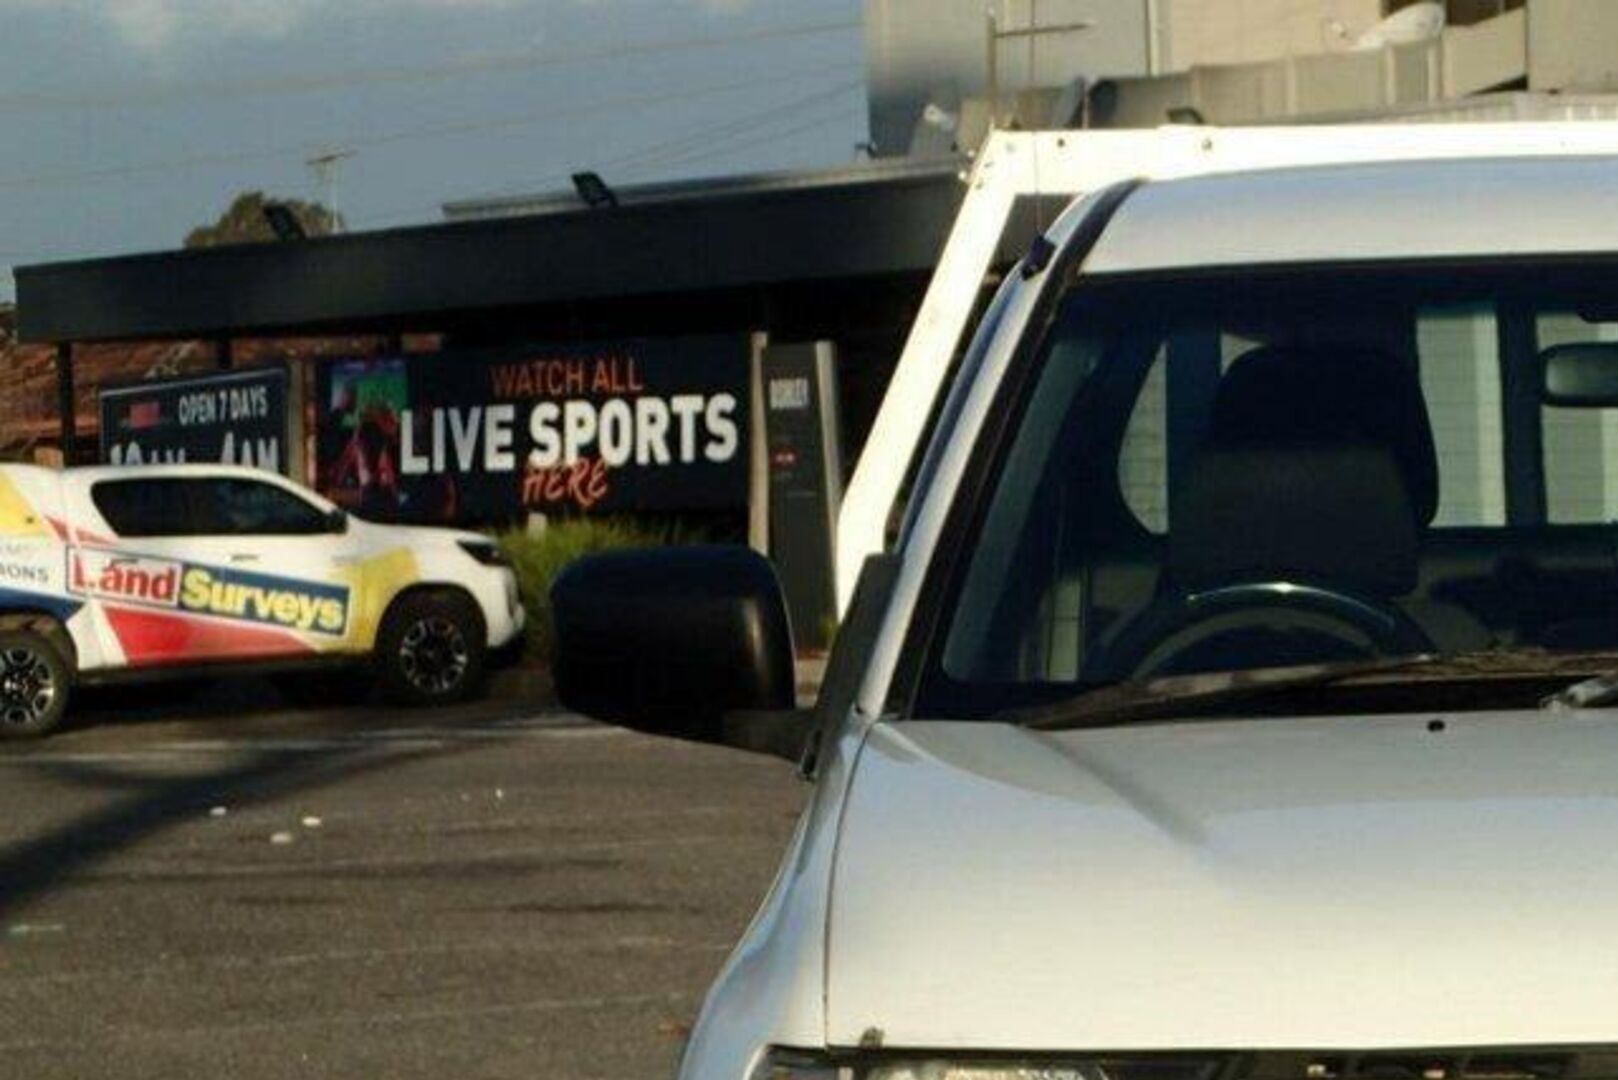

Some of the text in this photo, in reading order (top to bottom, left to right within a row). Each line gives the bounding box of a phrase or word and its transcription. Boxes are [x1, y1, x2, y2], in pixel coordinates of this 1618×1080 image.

[490, 356, 645, 397] WATCH ALL
[178, 386, 268, 426] OPEN 7 DAYS
[401, 403, 516, 475] LIVE
[528, 392, 738, 467] SPORTS
[522, 456, 609, 507] HERE
[72, 554, 346, 631] Land Surveys
